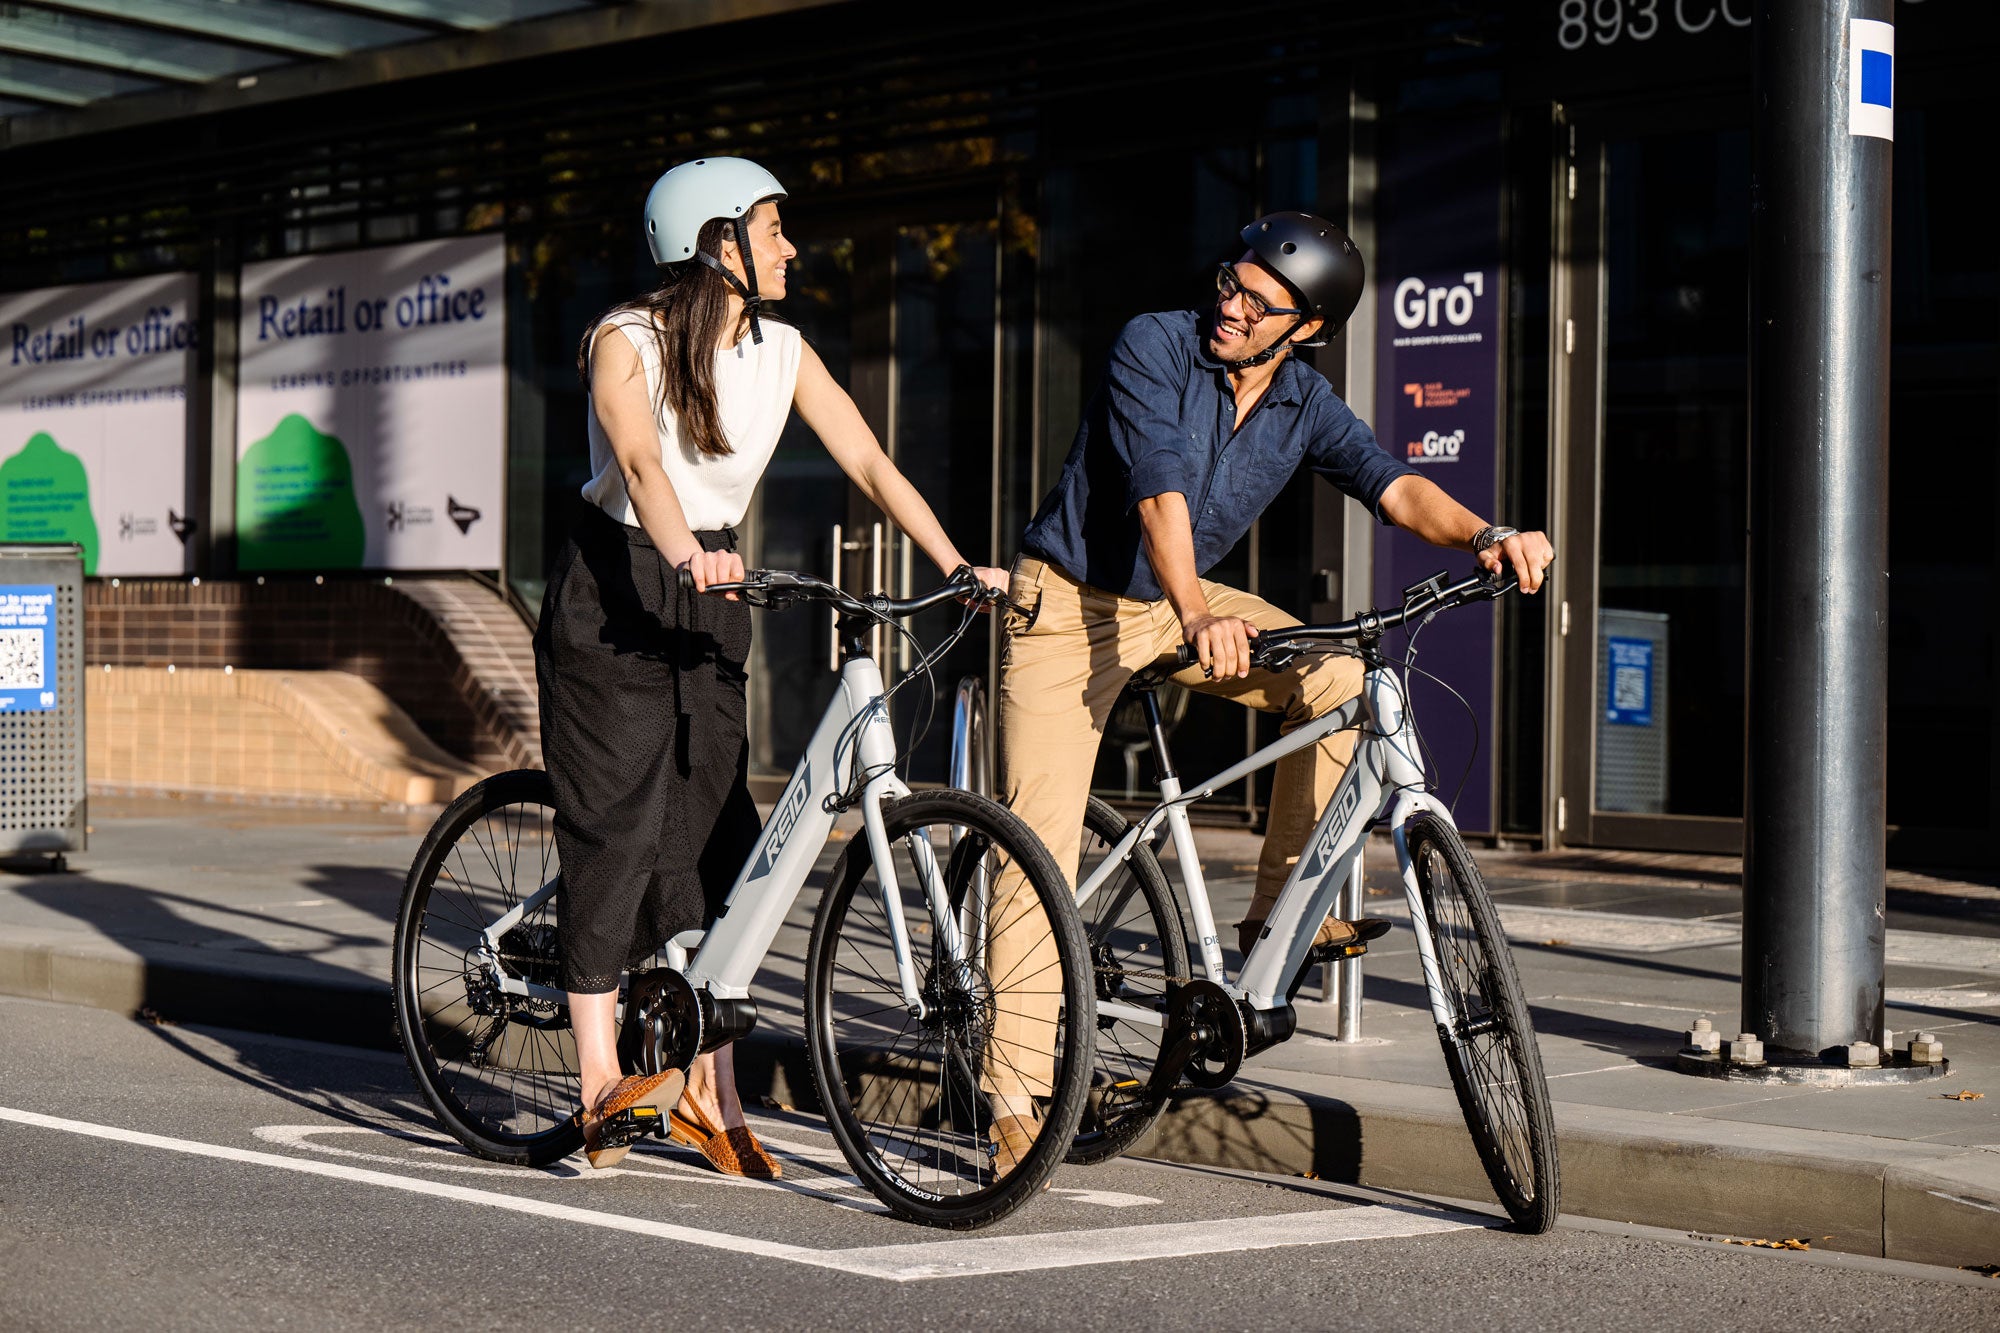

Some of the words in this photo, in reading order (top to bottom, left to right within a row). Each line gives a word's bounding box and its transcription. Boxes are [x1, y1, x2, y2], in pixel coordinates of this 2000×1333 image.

[1558, 0, 1658, 49] 893
[258, 286, 346, 341] Retail
[354, 298, 387, 332] or
[396, 272, 486, 327] office
[11, 315, 85, 366] Retail
[92, 325, 119, 357] or
[126, 306, 200, 356] office
[22, 393, 75, 411] LEASING
[81, 384, 187, 406] OPPORTUNITIES
[271, 372, 335, 391] LEASING
[341, 360, 468, 386] OPPORTUNITIES
[765, 778, 807, 870] REID
[1317, 784, 1357, 870] REID
[895, 1178, 945, 1202] ALEXRIMS
